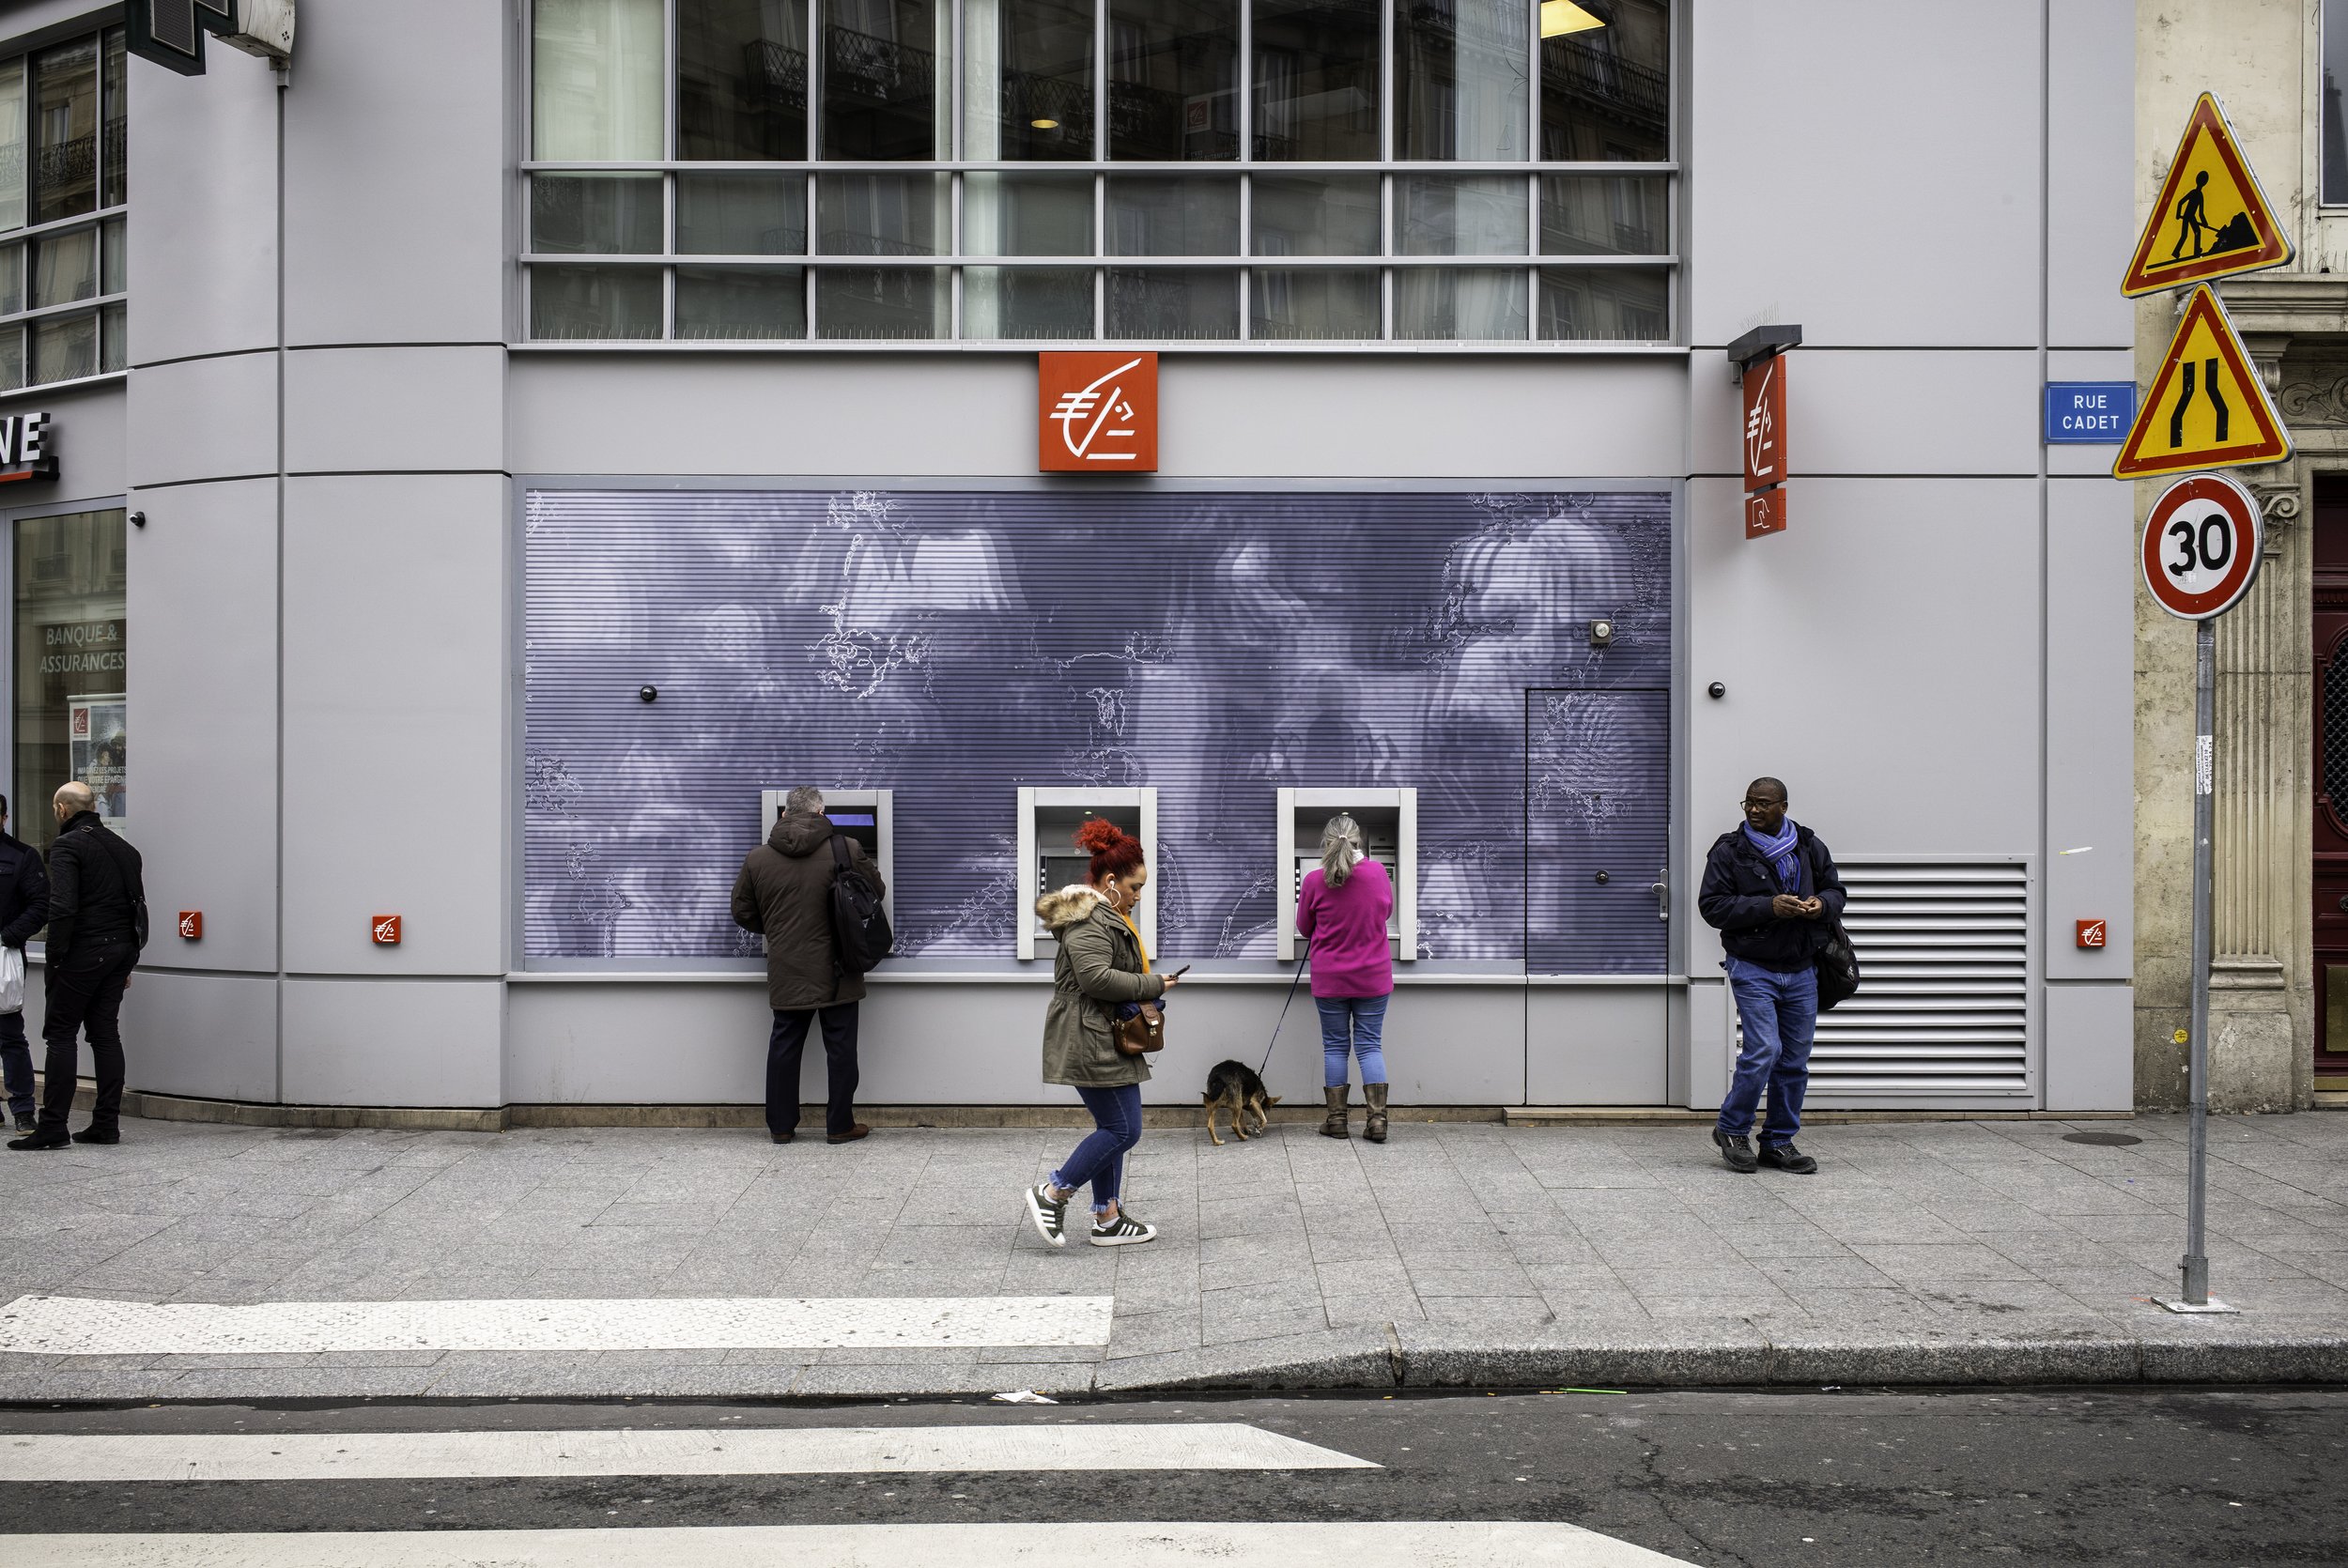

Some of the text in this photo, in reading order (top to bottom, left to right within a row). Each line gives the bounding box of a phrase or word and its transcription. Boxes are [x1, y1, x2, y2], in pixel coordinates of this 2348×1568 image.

[2074, 394, 2108, 409] RUE
[2062, 415, 2120, 429] CADET
[2168, 513, 2232, 577] 30
[46, 623, 118, 648] BANQUE &
[39, 652, 125, 673] ASSURANCES
